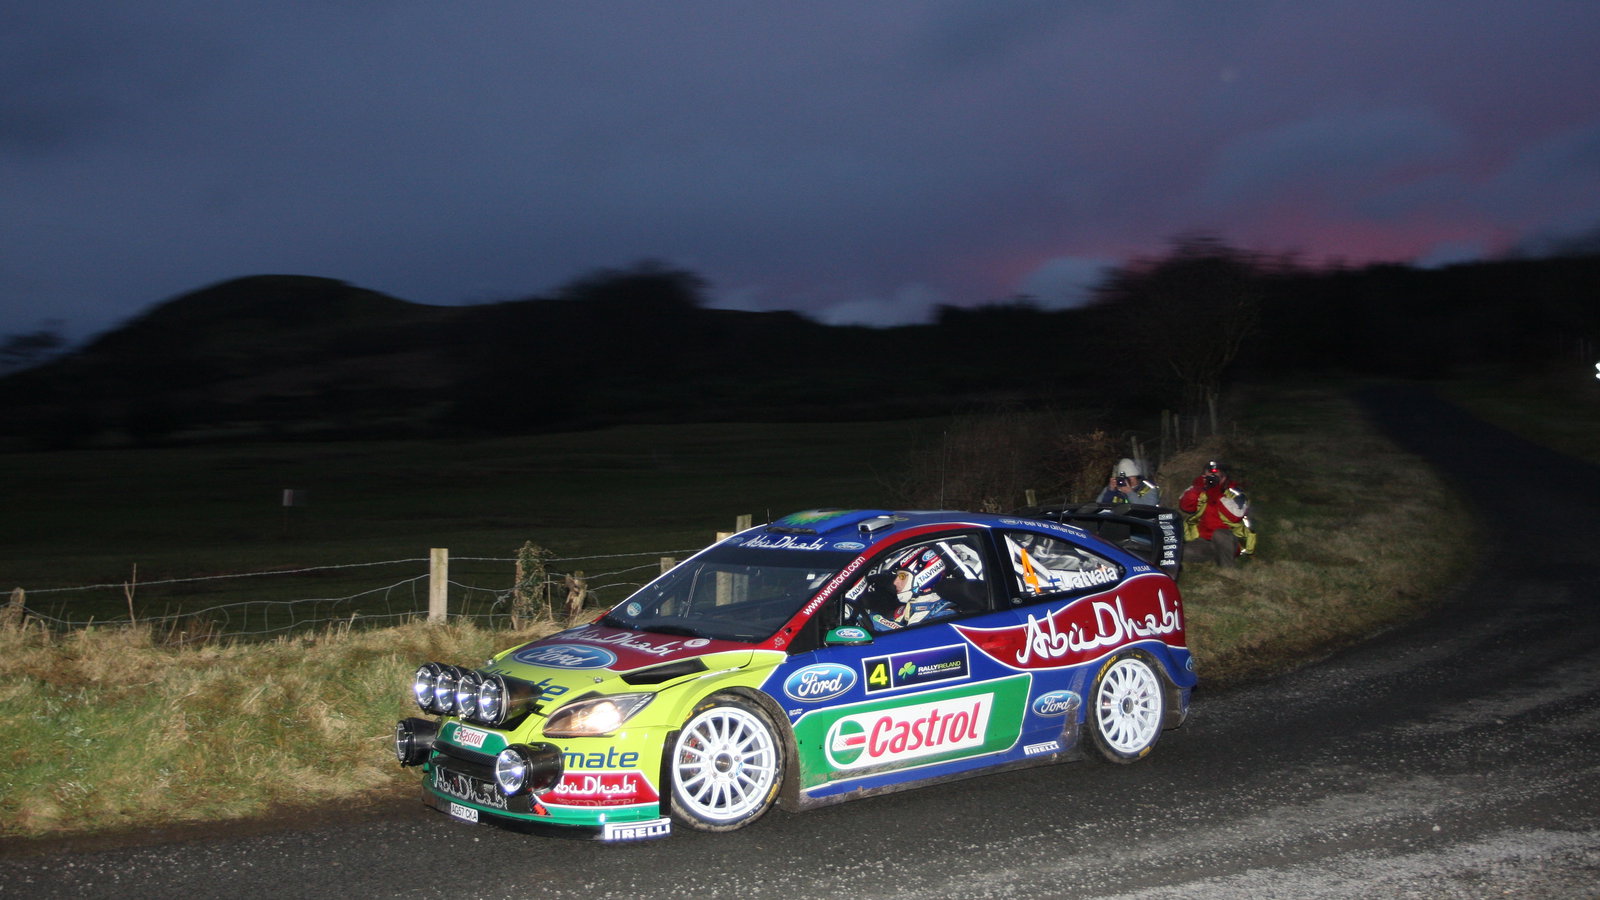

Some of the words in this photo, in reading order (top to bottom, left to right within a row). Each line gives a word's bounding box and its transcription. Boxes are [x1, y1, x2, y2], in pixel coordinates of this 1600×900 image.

[1020, 548, 1042, 593] 4
[803, 555, 866, 616] www.wrcford.com
[527, 644, 599, 666] Ford
[798, 669, 843, 697] Ford
[869, 663, 888, 686] 4
[1041, 695, 1072, 713] Ford
[460, 729, 485, 748] Castrol
[869, 701, 981, 758] Castrol
[1023, 740, 1060, 756] PIRELLI
[451, 803, 465, 816] AG57
[465, 807, 478, 821] CKA
[604, 817, 672, 840] PIRELLI
